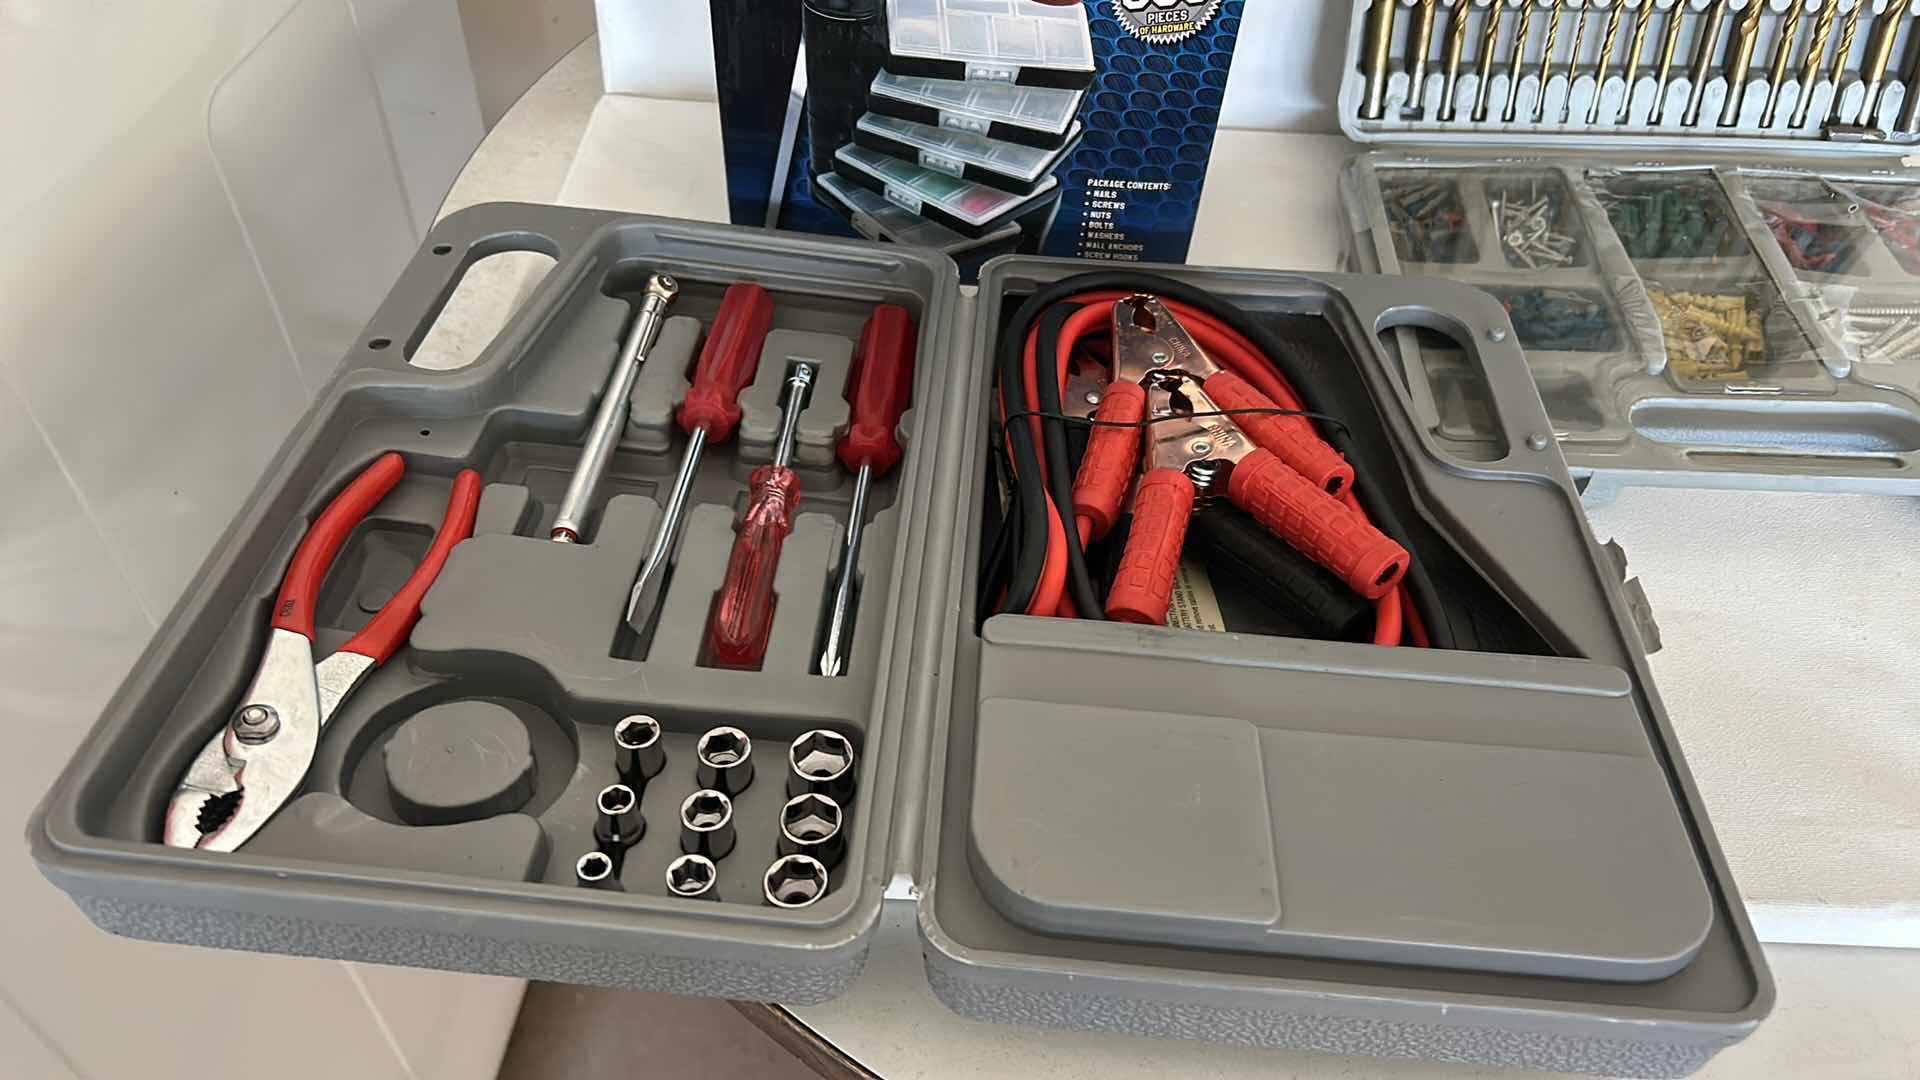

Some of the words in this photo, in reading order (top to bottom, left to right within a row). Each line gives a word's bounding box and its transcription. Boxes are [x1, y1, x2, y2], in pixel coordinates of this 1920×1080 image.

[1147, 10, 1188, 24] PIECES
[1140, 26, 1150, 35] OF
[1151, 22, 1195, 34] HARDWARE
[1087, 179, 1126, 189] PACKAGE
[1127, 181, 1173, 191] CONTENTS:
[1093, 190, 1118, 199] NAILS
[1092, 201, 1126, 210] SCREWS
[1090, 211, 1112, 220] NUTS
[1088, 221, 1115, 230] BOLTS
[1087, 232, 1125, 241] WASHERS
[1086, 242, 1106, 250] WALL
[1108, 243, 1145, 252] ANCHORS
